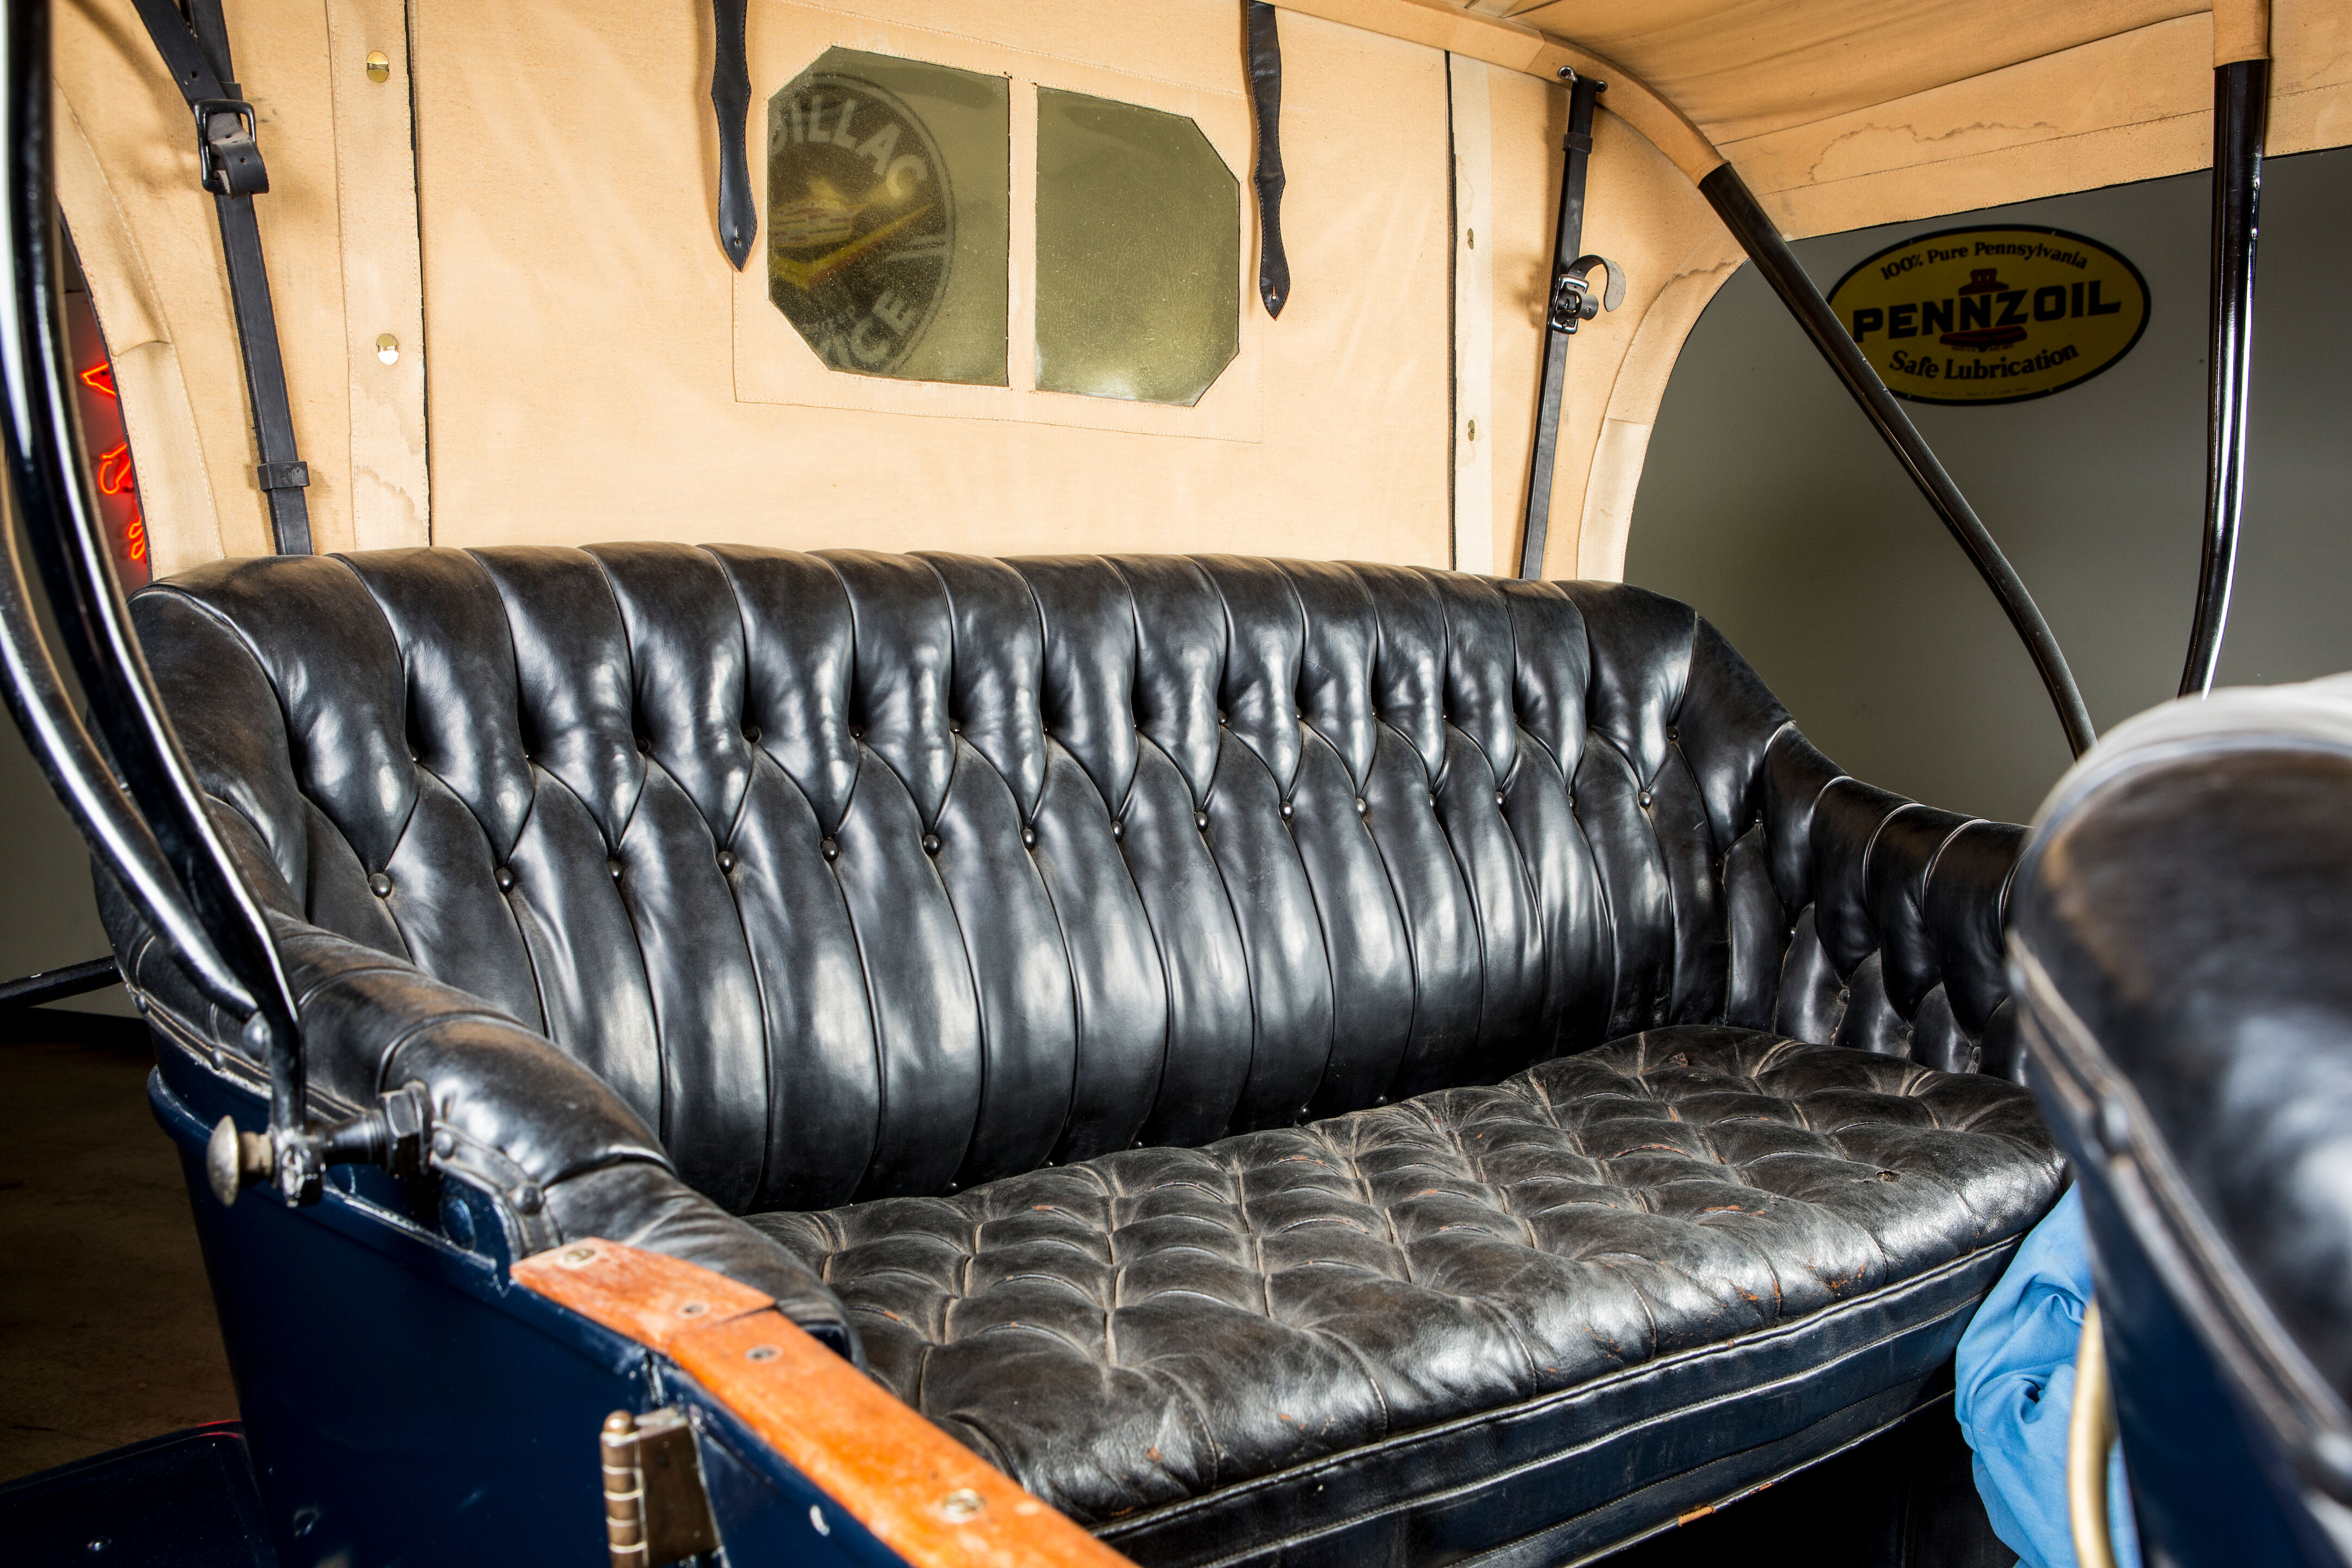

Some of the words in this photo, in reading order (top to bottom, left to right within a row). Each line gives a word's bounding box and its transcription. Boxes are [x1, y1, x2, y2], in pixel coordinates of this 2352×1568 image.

[1880, 254, 1924, 280] 100%
[1928, 244, 1969, 264] Pure
[1974, 241, 2088, 270] Pennsylvania
[1852, 280, 2122, 343] PENNZOIL
[1889, 349, 1939, 379] Safe
[1944, 344, 2079, 380] Lubrication
